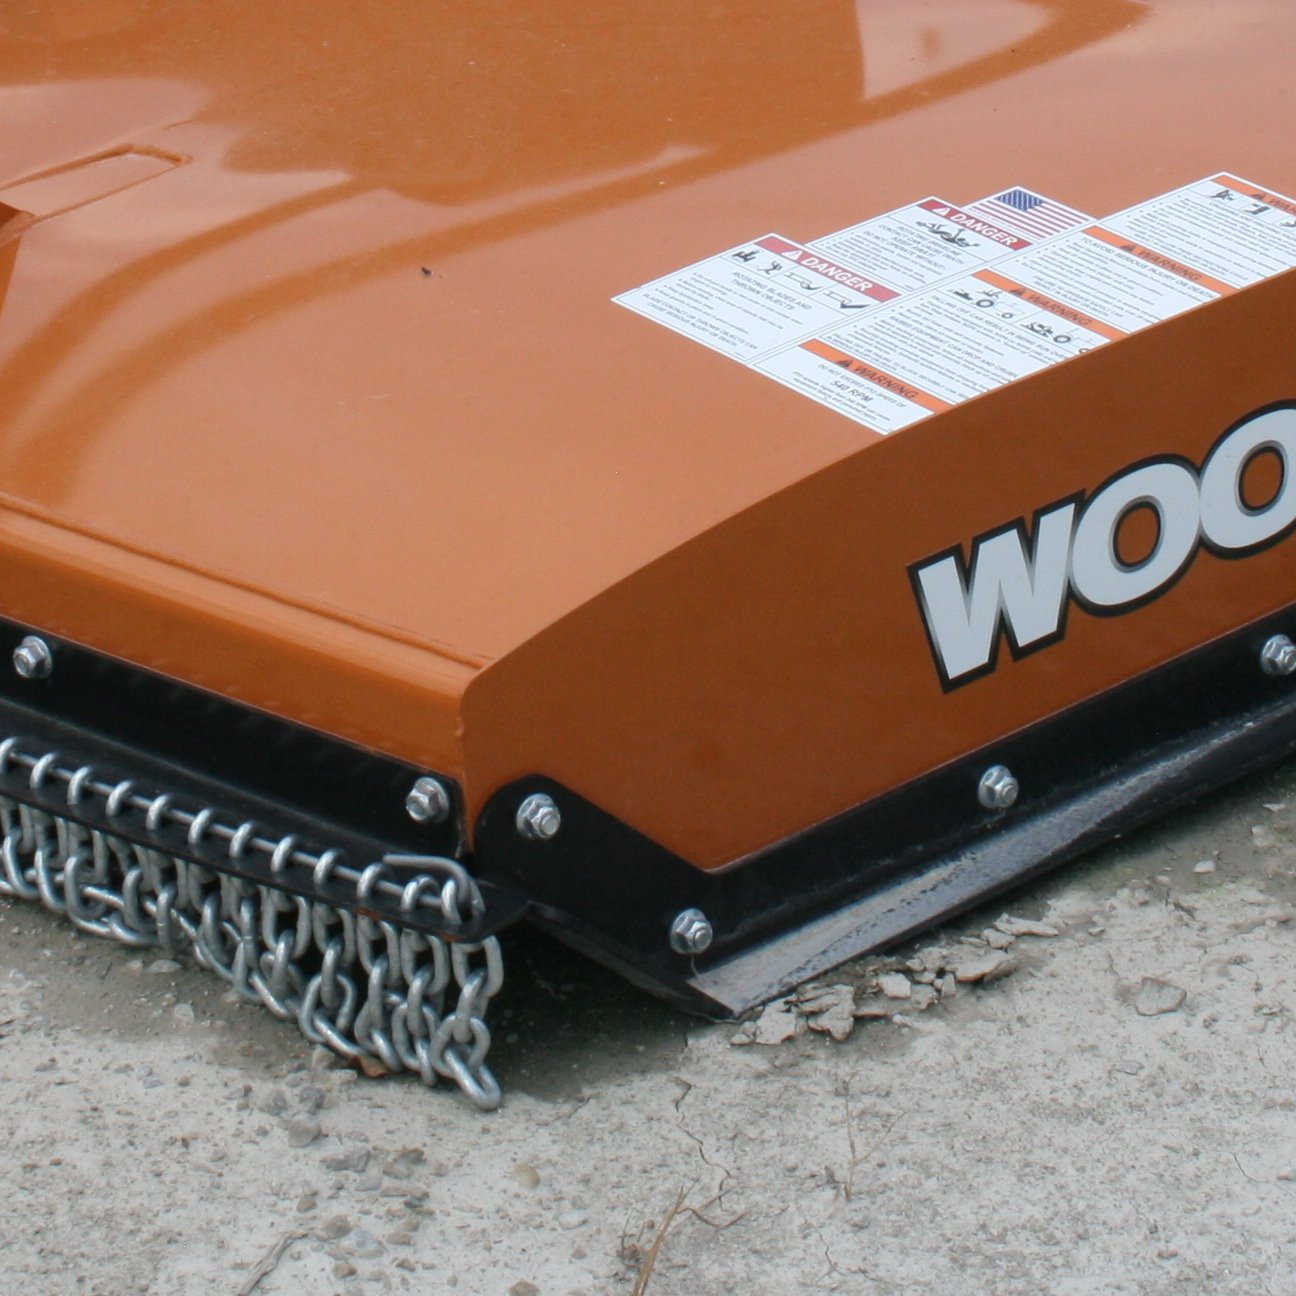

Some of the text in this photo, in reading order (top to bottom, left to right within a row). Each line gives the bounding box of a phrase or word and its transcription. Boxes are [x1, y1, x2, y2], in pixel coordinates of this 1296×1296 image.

[950, 212, 1019, 246] DANGER
[800, 257, 873, 292] DANGER
[1139, 250, 1203, 281] WARNING
[1029, 293, 1092, 326] WARNING
[830, 380, 873, 402] 540 RPM
[854, 366, 919, 399] WARNING
